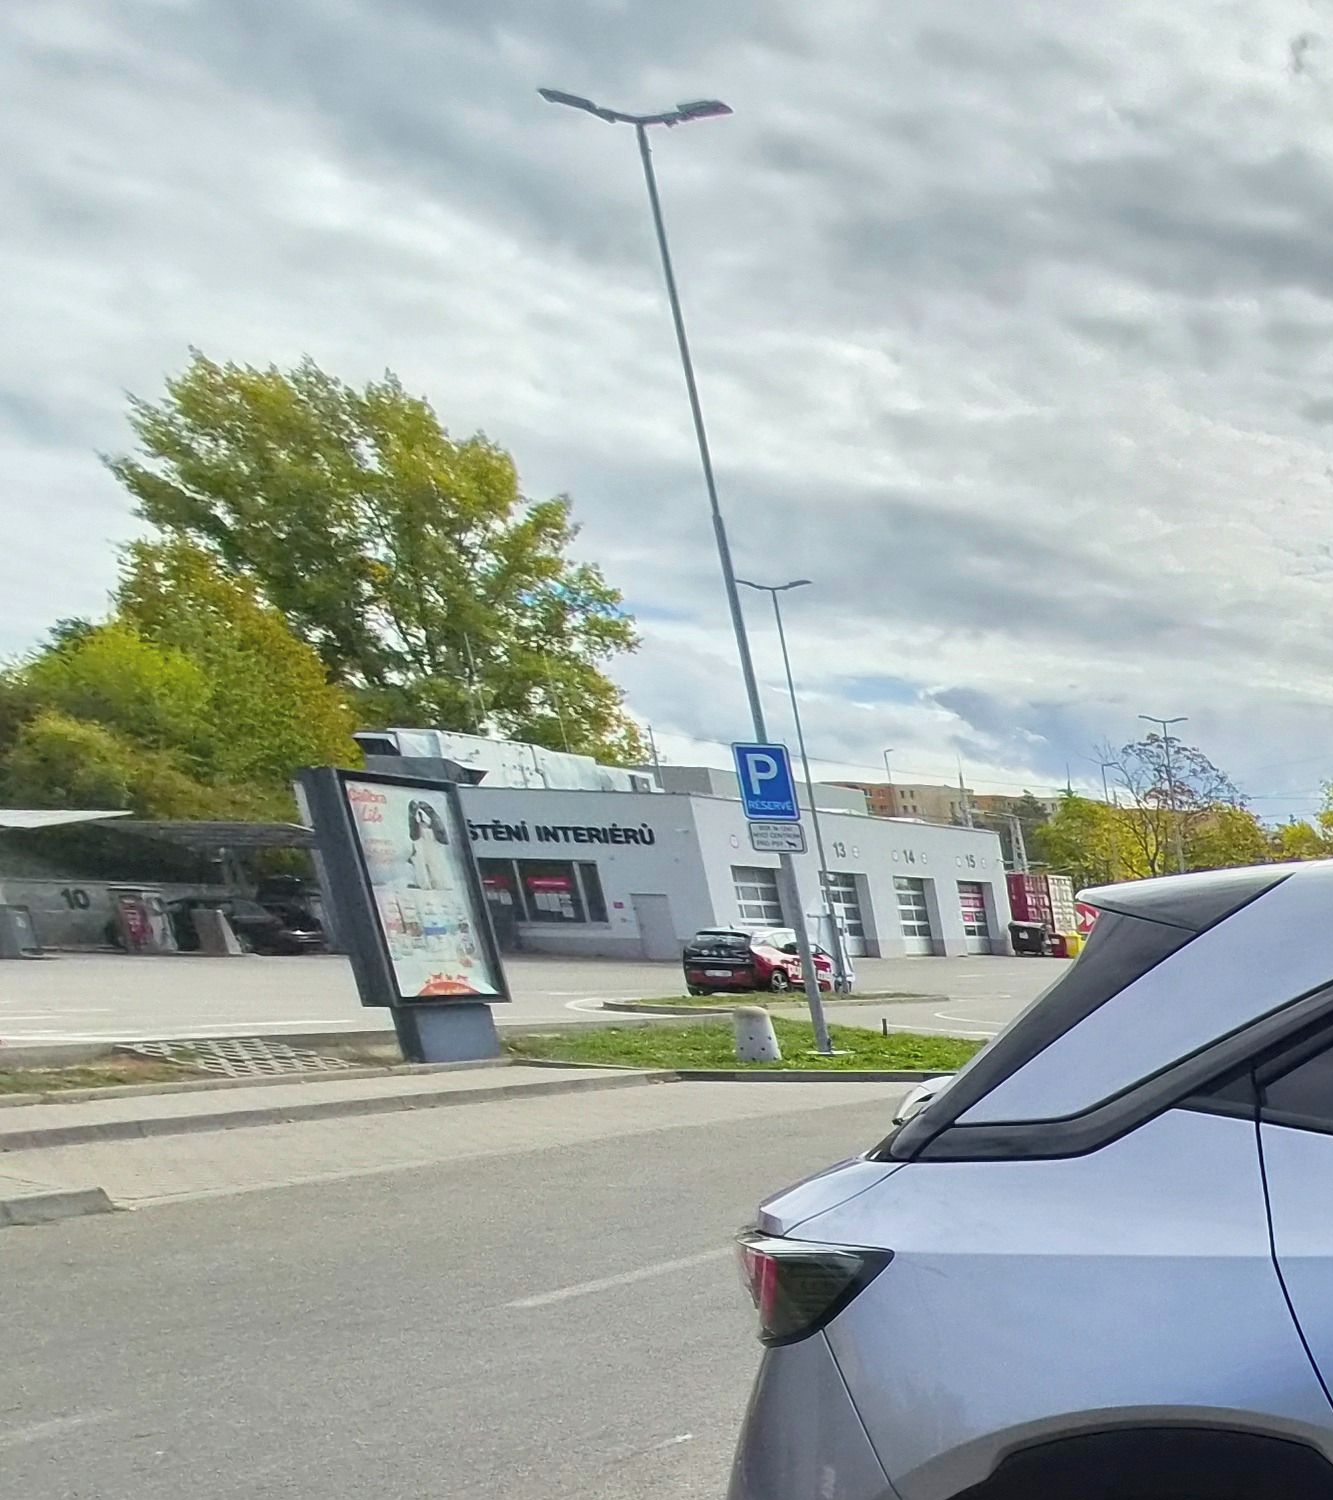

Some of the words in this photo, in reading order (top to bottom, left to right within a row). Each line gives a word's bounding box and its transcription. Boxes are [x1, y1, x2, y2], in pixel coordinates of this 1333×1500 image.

[745, 753, 778, 795] P
[535, 823, 656, 846] INTERIÉRŮ
[832, 841, 846, 858] 13
[903, 849, 916, 864] 14
[965, 854, 976, 868] 15
[61, 888, 90, 910] 10
